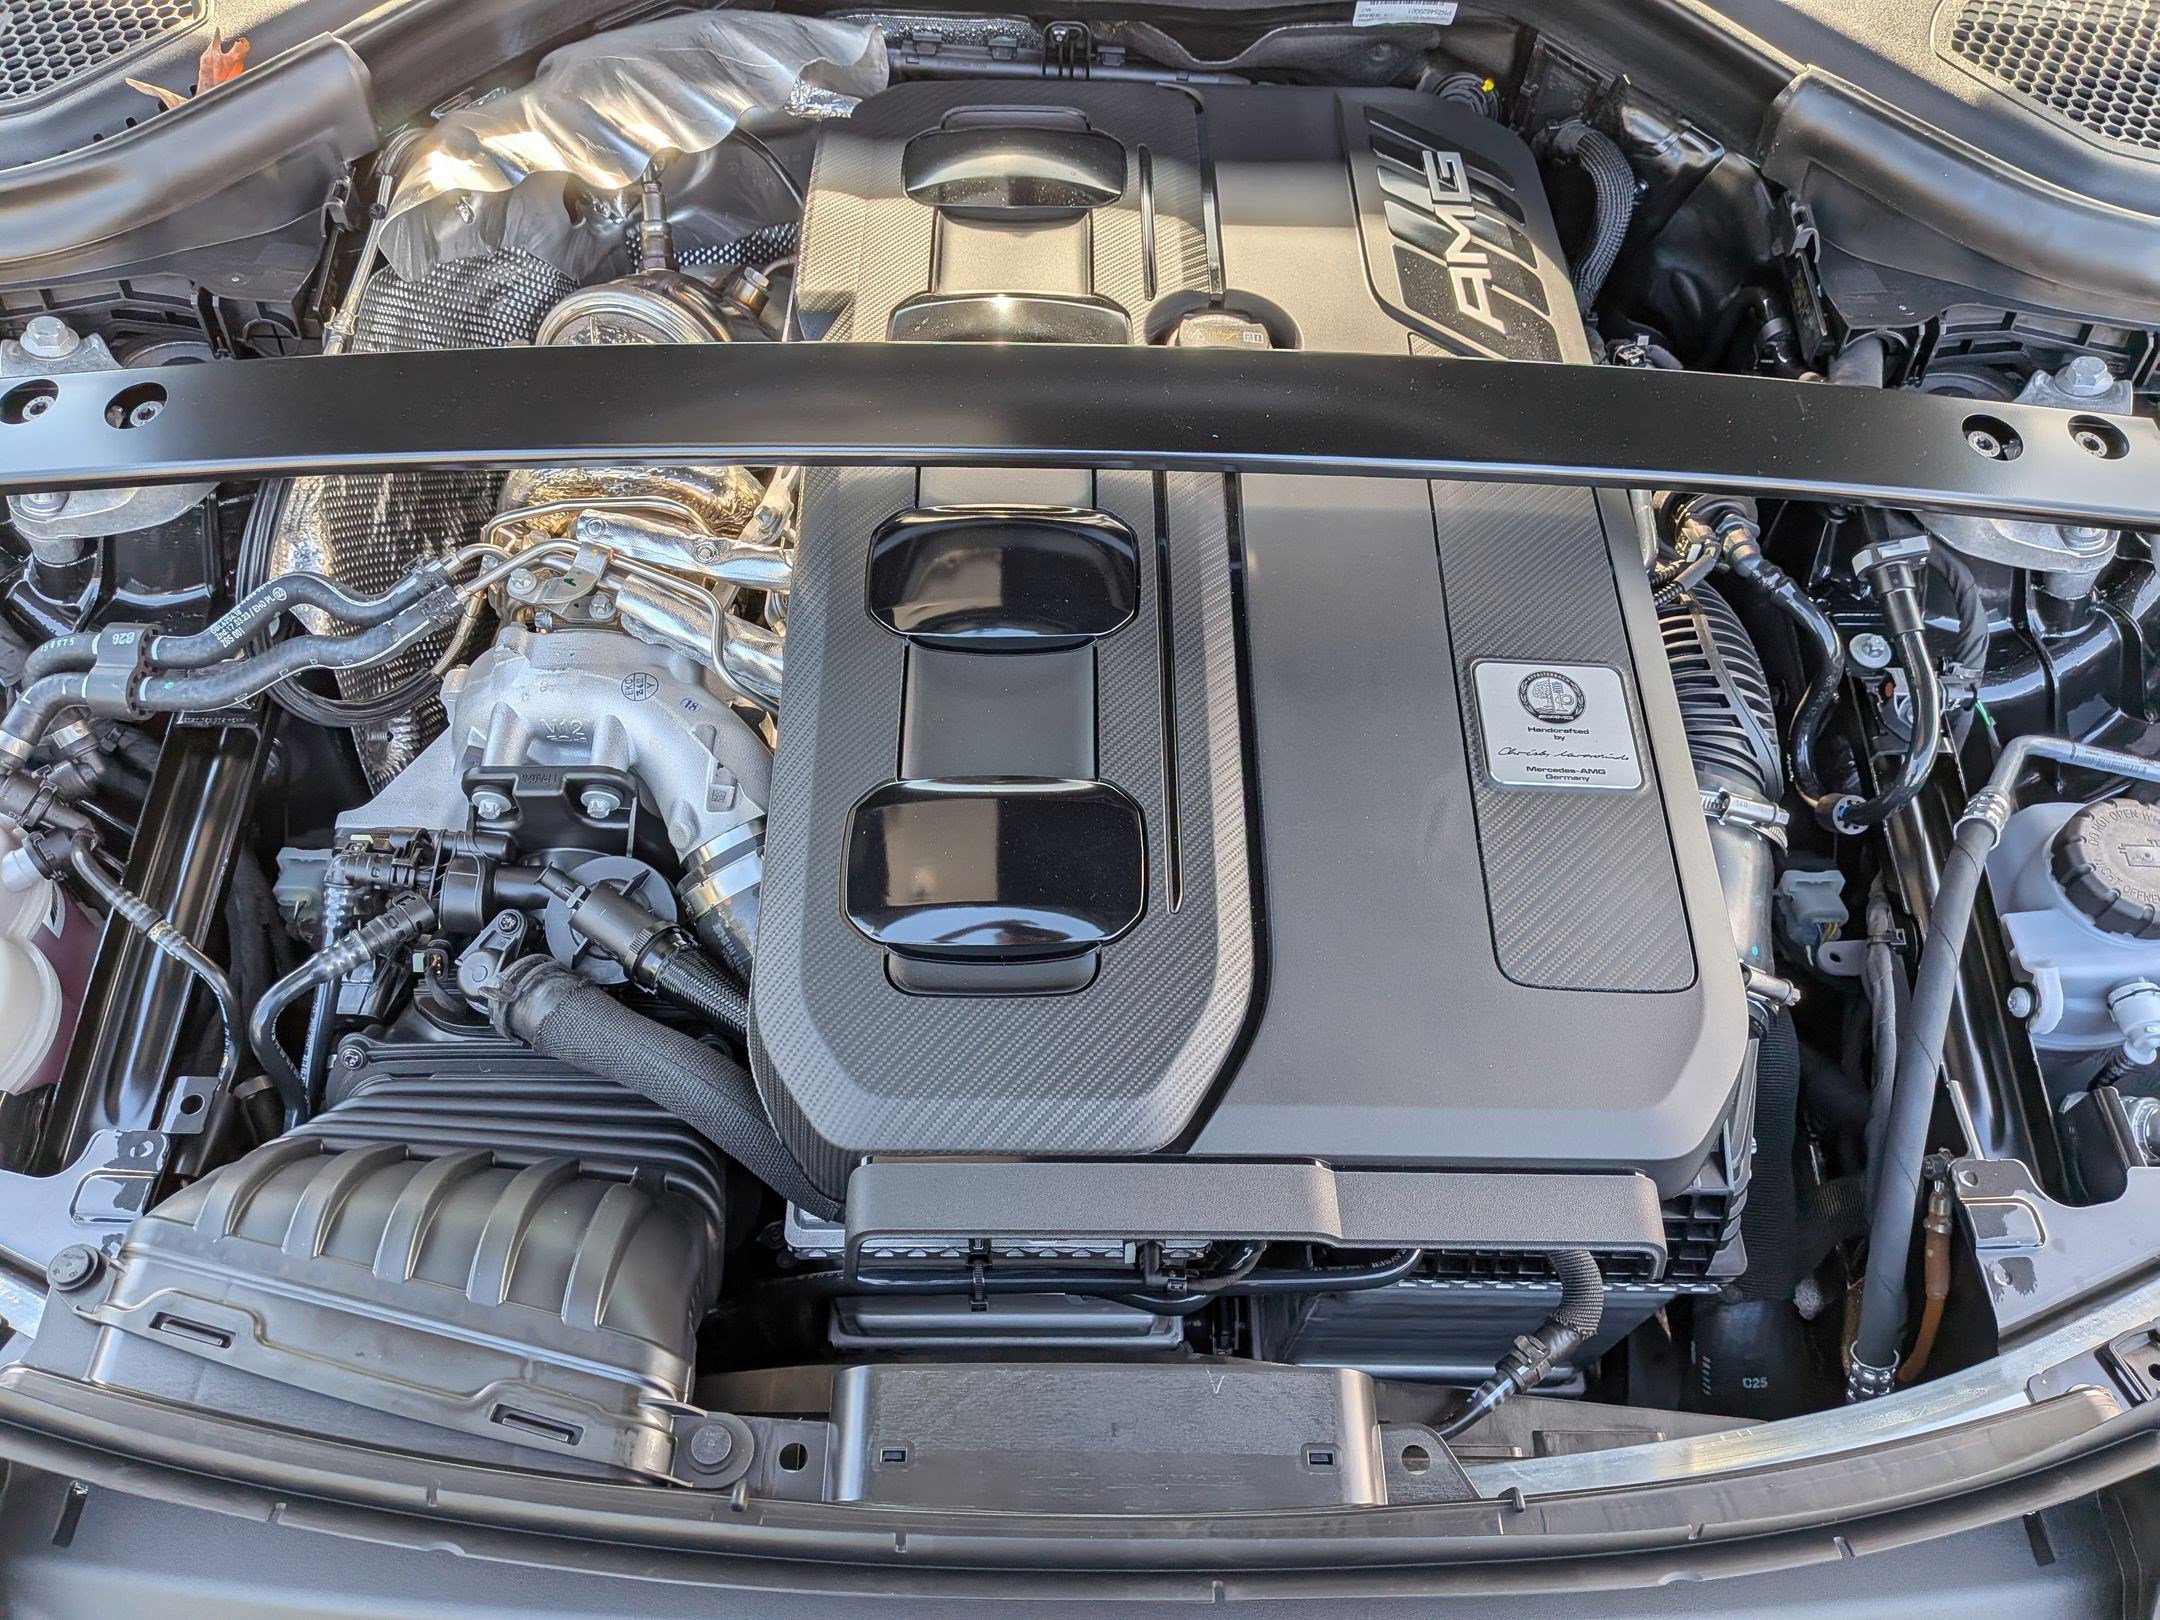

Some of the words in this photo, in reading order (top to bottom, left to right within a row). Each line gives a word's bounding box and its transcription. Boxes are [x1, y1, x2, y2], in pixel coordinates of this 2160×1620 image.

[1422, 150, 1508, 335] AMG
[220, 635, 235, 648] ZGS
[684, 699, 699, 712] 18
[1527, 726, 1590, 735] Handcrafted
[1553, 733, 1566, 741] by
[1526, 765, 1607, 775] Mercedes-AMG
[1545, 773, 1590, 782] Germany
[2108, 808, 2138, 820] OPEN
[2091, 816, 2111, 833] NOT
[2087, 831, 2100, 846] DO
[1742, 1376, 1768, 1389] C25
